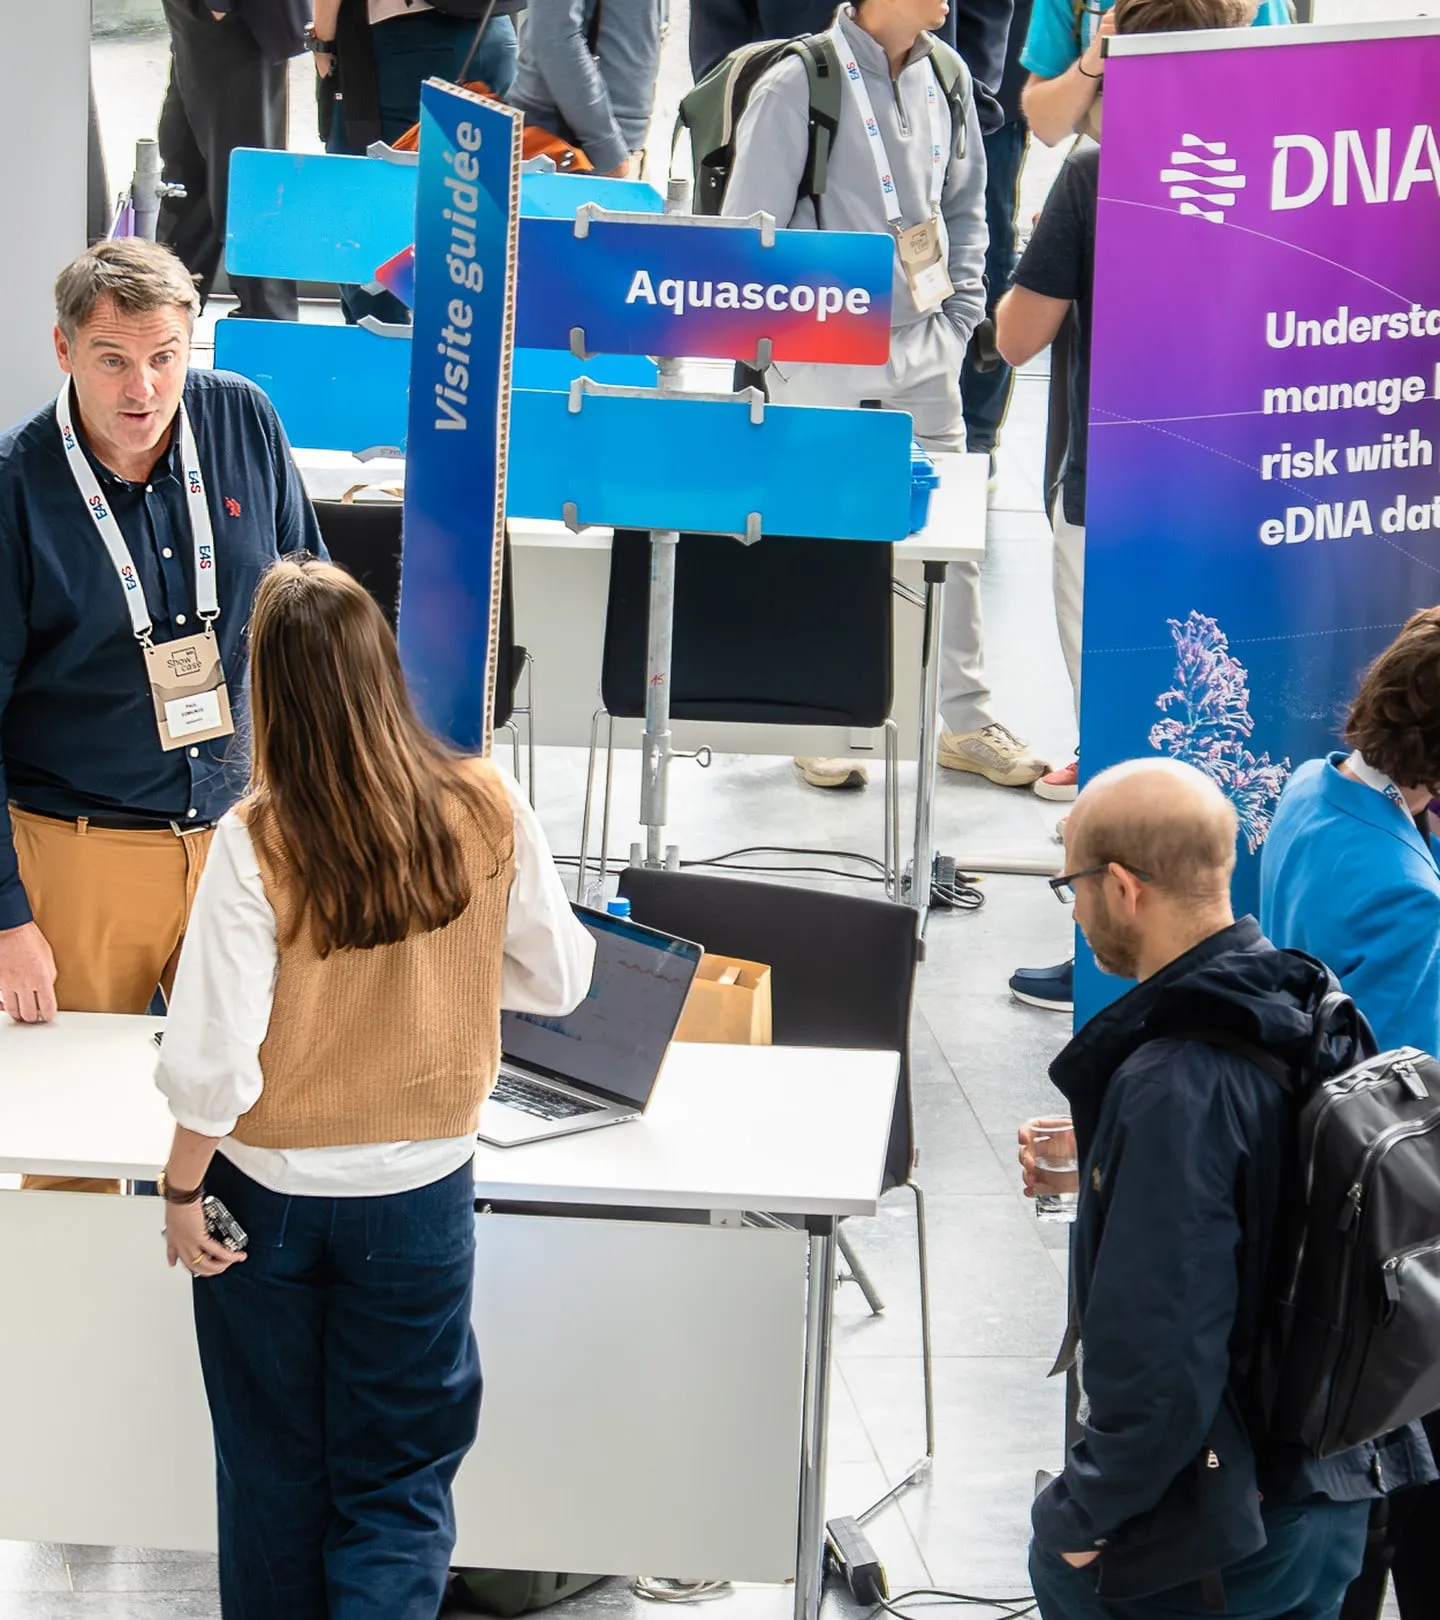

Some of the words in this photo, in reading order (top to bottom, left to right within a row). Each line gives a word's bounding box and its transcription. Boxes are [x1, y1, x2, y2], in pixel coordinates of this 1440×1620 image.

[846, 61, 860, 81] EAS
[865, 118, 878, 137] EAS
[881, 174, 894, 194] EAS
[442, 120, 484, 293] guidée
[625, 268, 872, 322] Aquascope
[435, 305, 475, 432] Visite
[1263, 375, 1426, 416] manage
[1261, 437, 1339, 481] risk
[1345, 428, 1433, 474] with
[188, 470, 201, 494] EAS
[89, 495, 107, 521] EAS
[1259, 499, 1374, 546] eDNA
[199, 544, 212, 570] EAS
[121, 565, 137, 591] EAS
